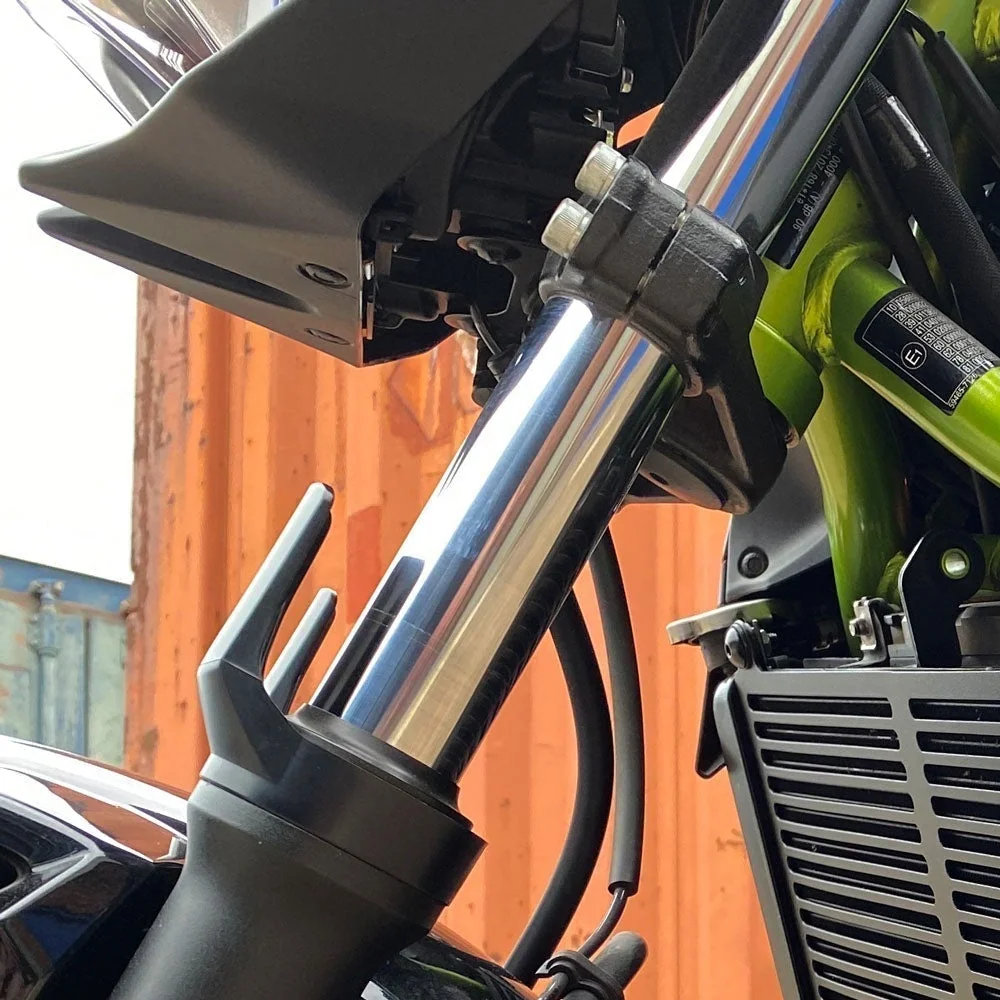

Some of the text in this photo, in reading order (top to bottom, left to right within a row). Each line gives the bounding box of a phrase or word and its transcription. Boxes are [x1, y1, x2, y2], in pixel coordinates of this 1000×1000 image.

[792, 218, 806, 232] 90
[824, 155, 841, 178] 4000
[886, 303, 898, 313] 10
[894, 310, 907, 321] 28
[904, 318, 917, 329] 39
[915, 326, 926, 335] 41
[923, 333, 936, 344] 53
[933, 340, 945, 351] 60
[905, 348, 923, 366] E1
[942, 347, 954, 358] 62
[952, 355, 964, 365] 78
[962, 364, 974, 373] 81
